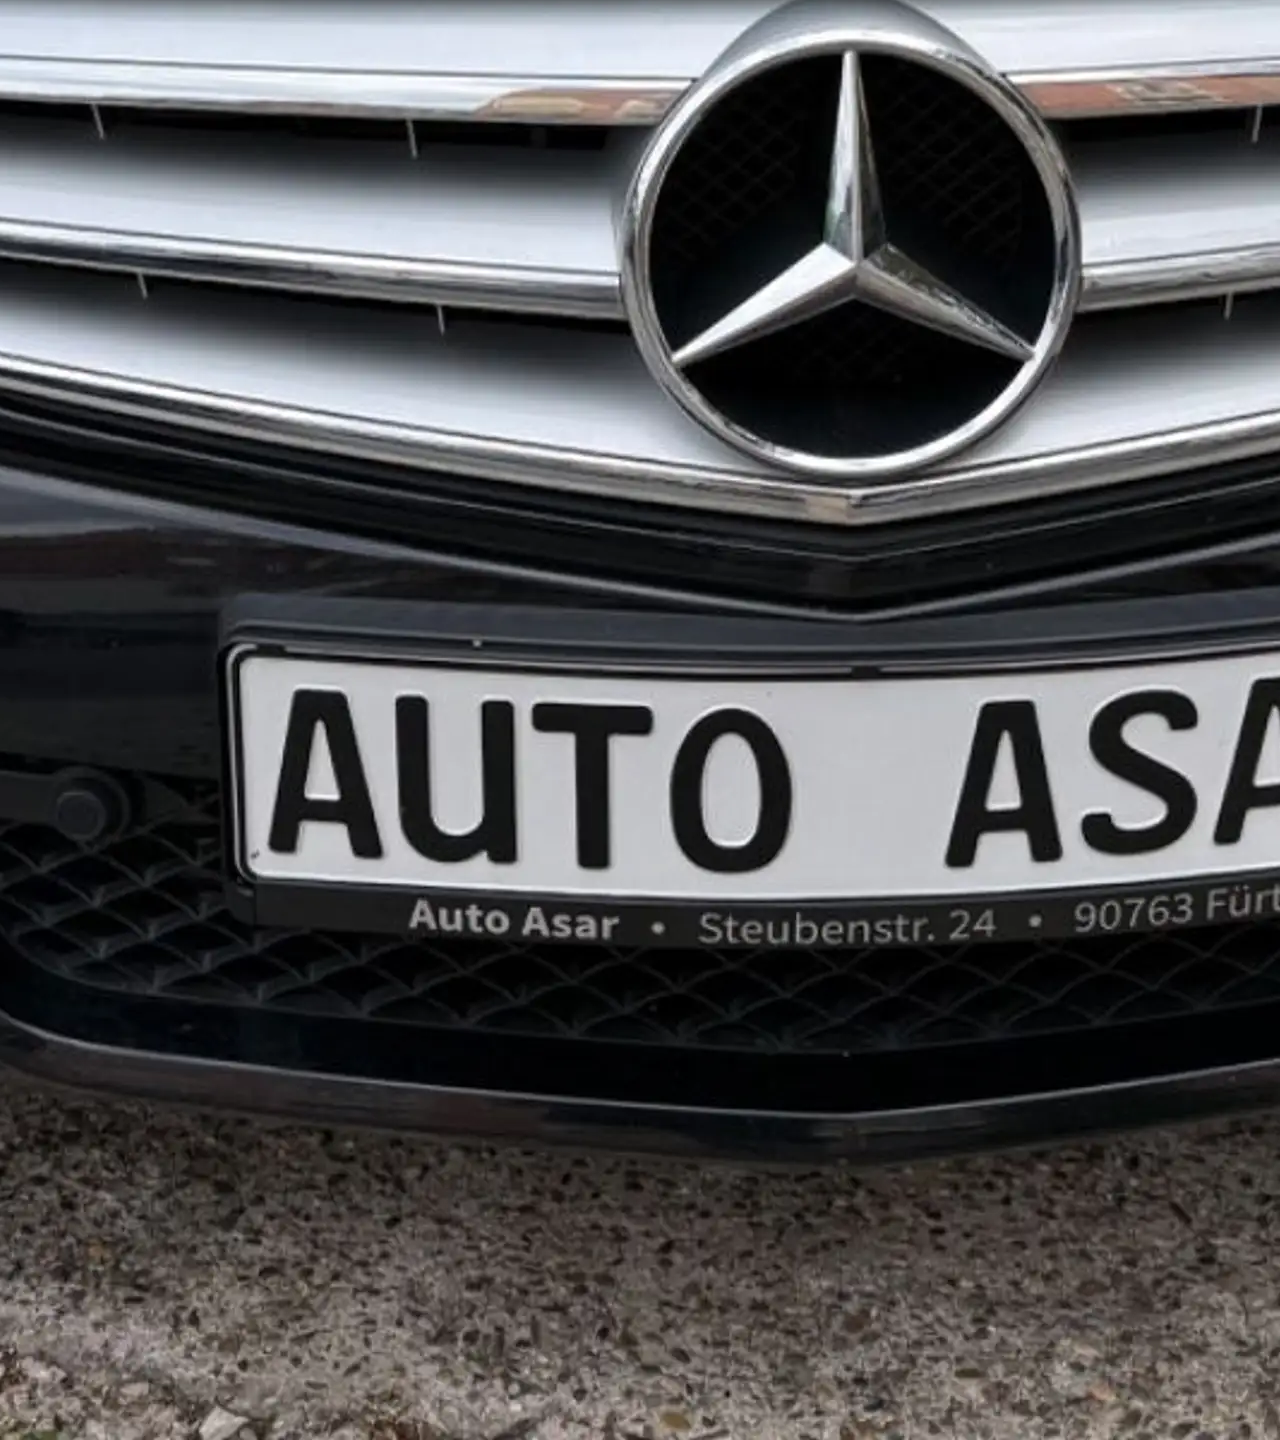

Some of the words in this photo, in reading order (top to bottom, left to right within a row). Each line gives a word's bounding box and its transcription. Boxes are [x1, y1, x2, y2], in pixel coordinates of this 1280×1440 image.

[269, 689, 793, 874] AUTO
[408, 899, 510, 935] Auto
[522, 906, 620, 940] Asar
[699, 911, 935, 945] Steubenstr.
[949, 909, 996, 940] 24
[1074, 893, 1193, 933] 90763
